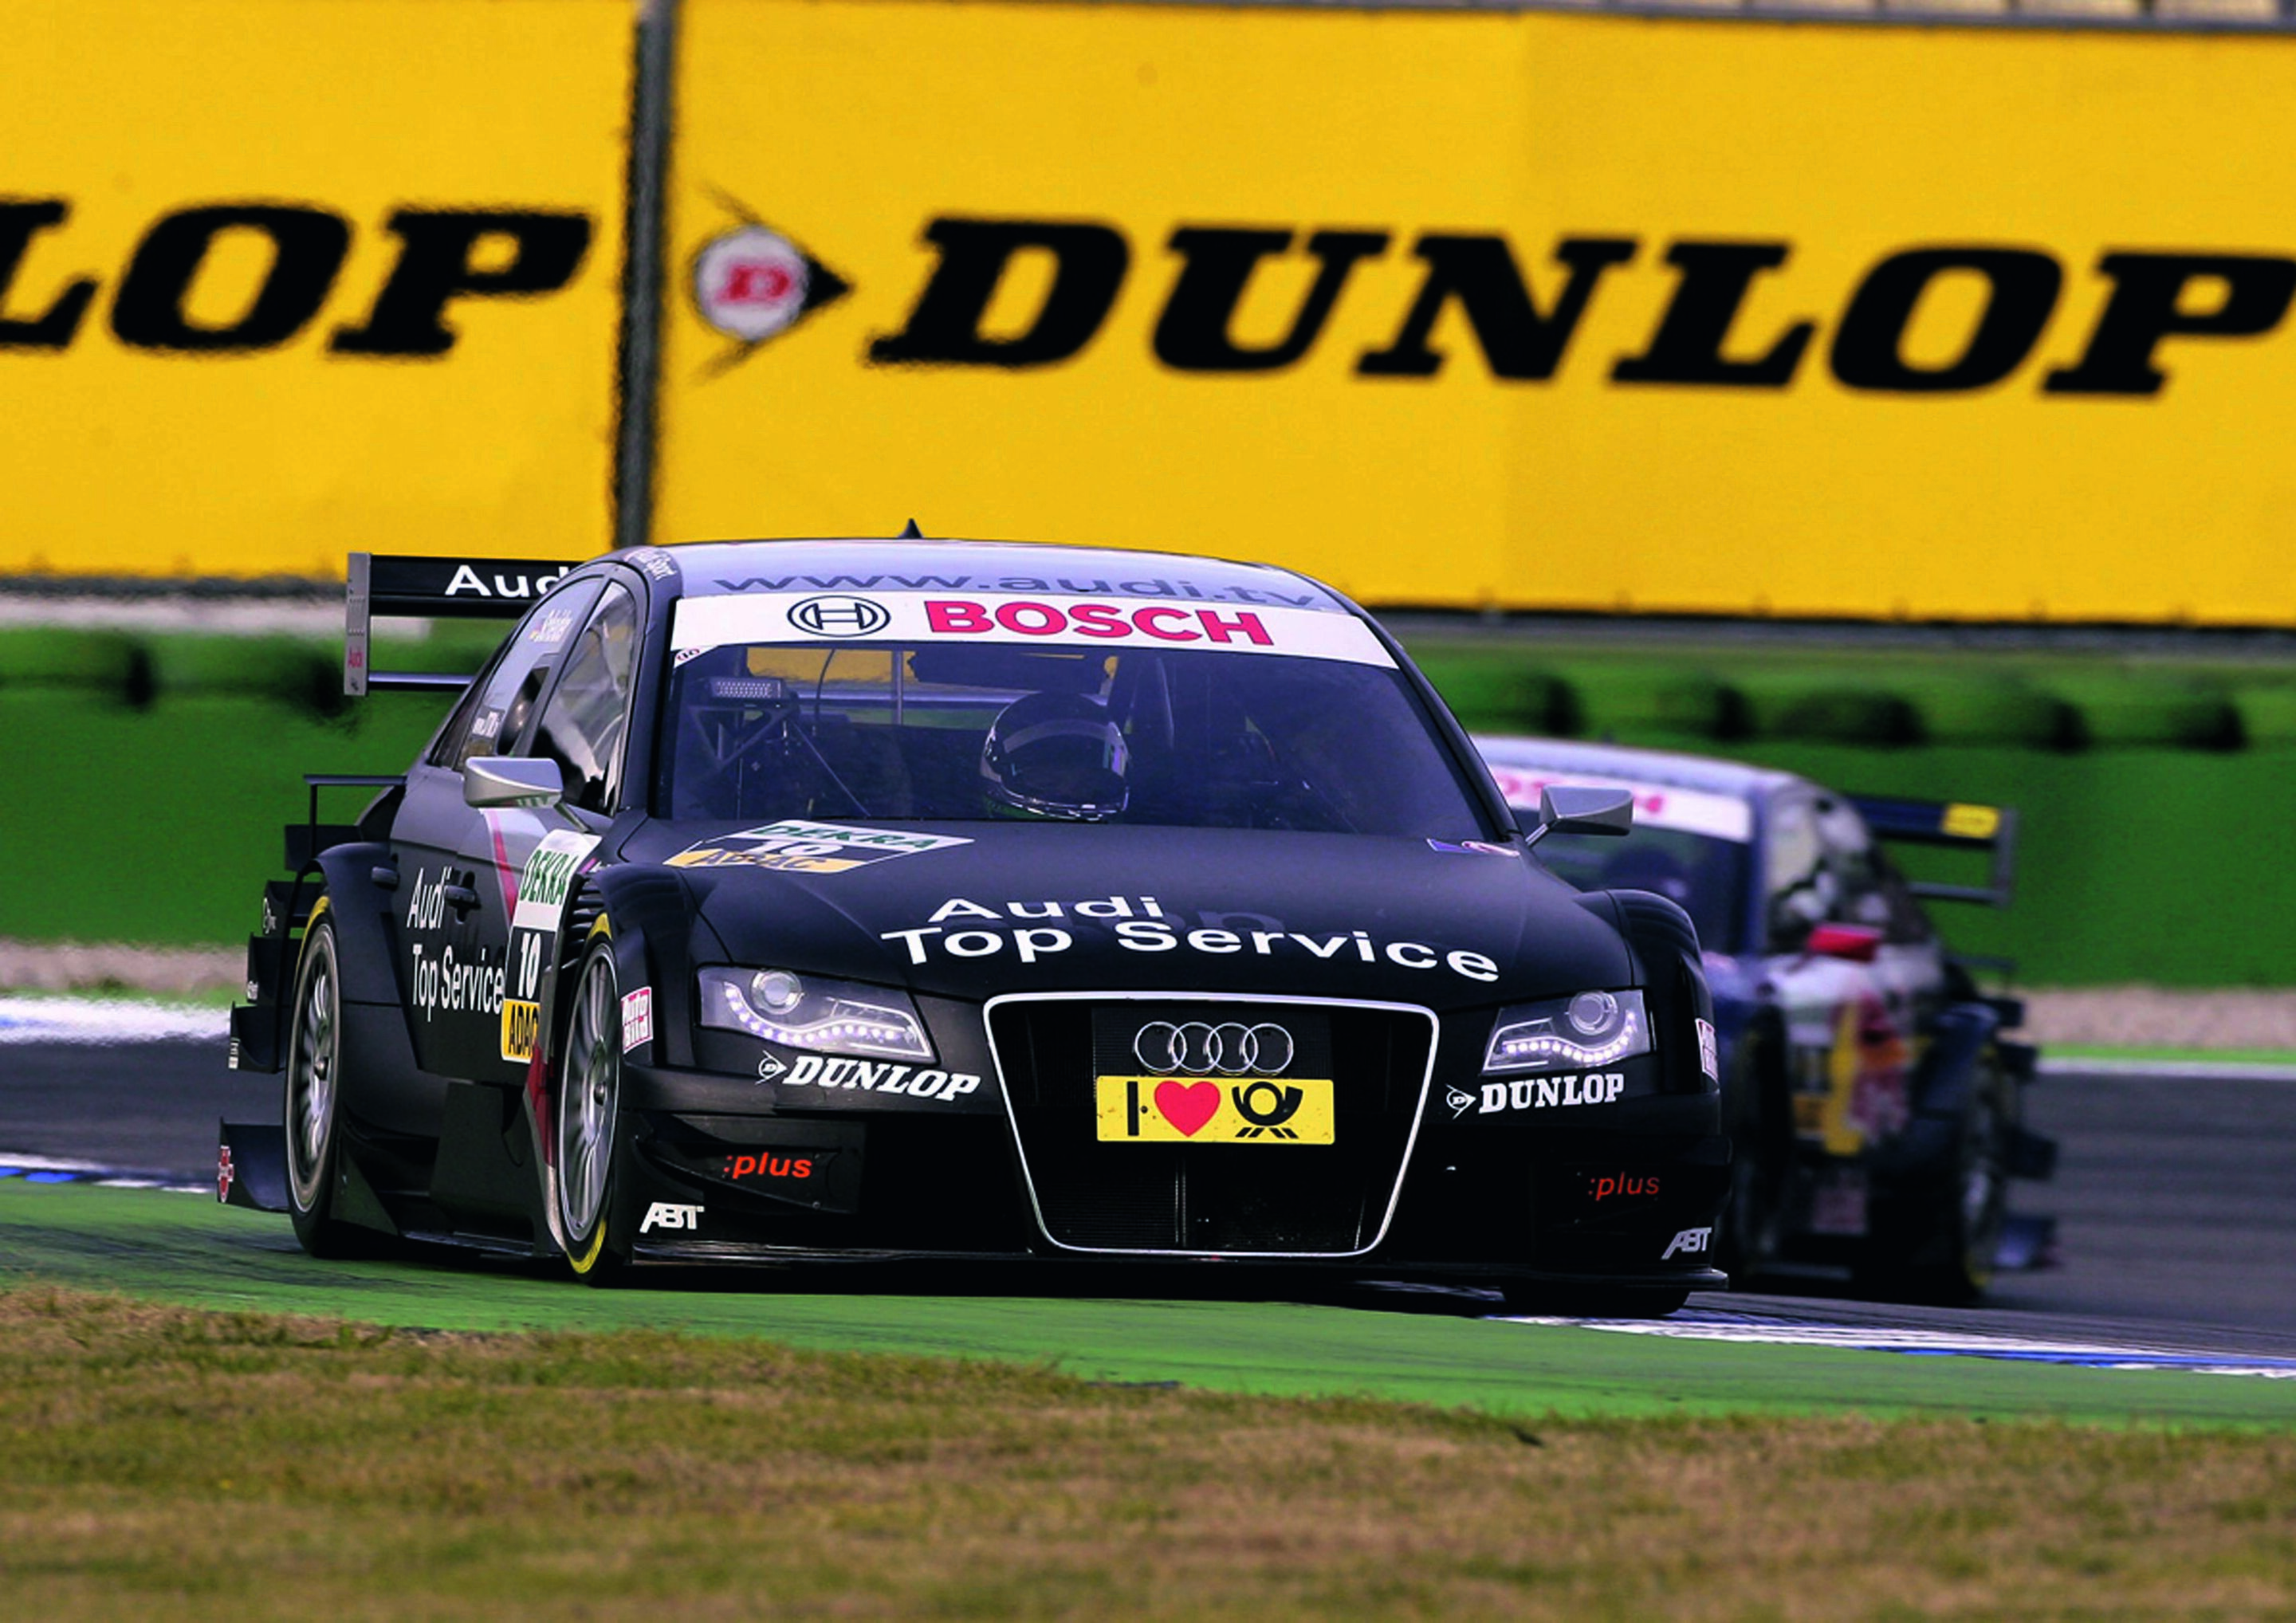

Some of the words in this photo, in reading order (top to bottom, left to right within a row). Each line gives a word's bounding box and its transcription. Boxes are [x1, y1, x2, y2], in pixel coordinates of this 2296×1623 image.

[866, 217, 2296, 400] DUNLOP
[712, 573, 1315, 609] www.audi.tv
[923, 599, 1275, 646] BOSCH
[749, 824, 938, 849] DEKRA
[407, 866, 450, 929] Audi
[520, 849, 579, 906] DEKRA
[926, 895, 1165, 923] Audi
[517, 932, 541, 1000] 10
[880, 925, 1074, 966] Top
[1114, 920, 1502, 983] Service
[412, 944, 438, 1023] Top
[440, 945, 505, 1015] Service
[782, 1055, 981, 1102] DUNLOP
[1479, 1074, 1625, 1114] DUNLOP
[1126, 1081, 1140, 1137] I
[639, 1202, 705, 1233] ABT
[1661, 1227, 1712, 1260] ABT
